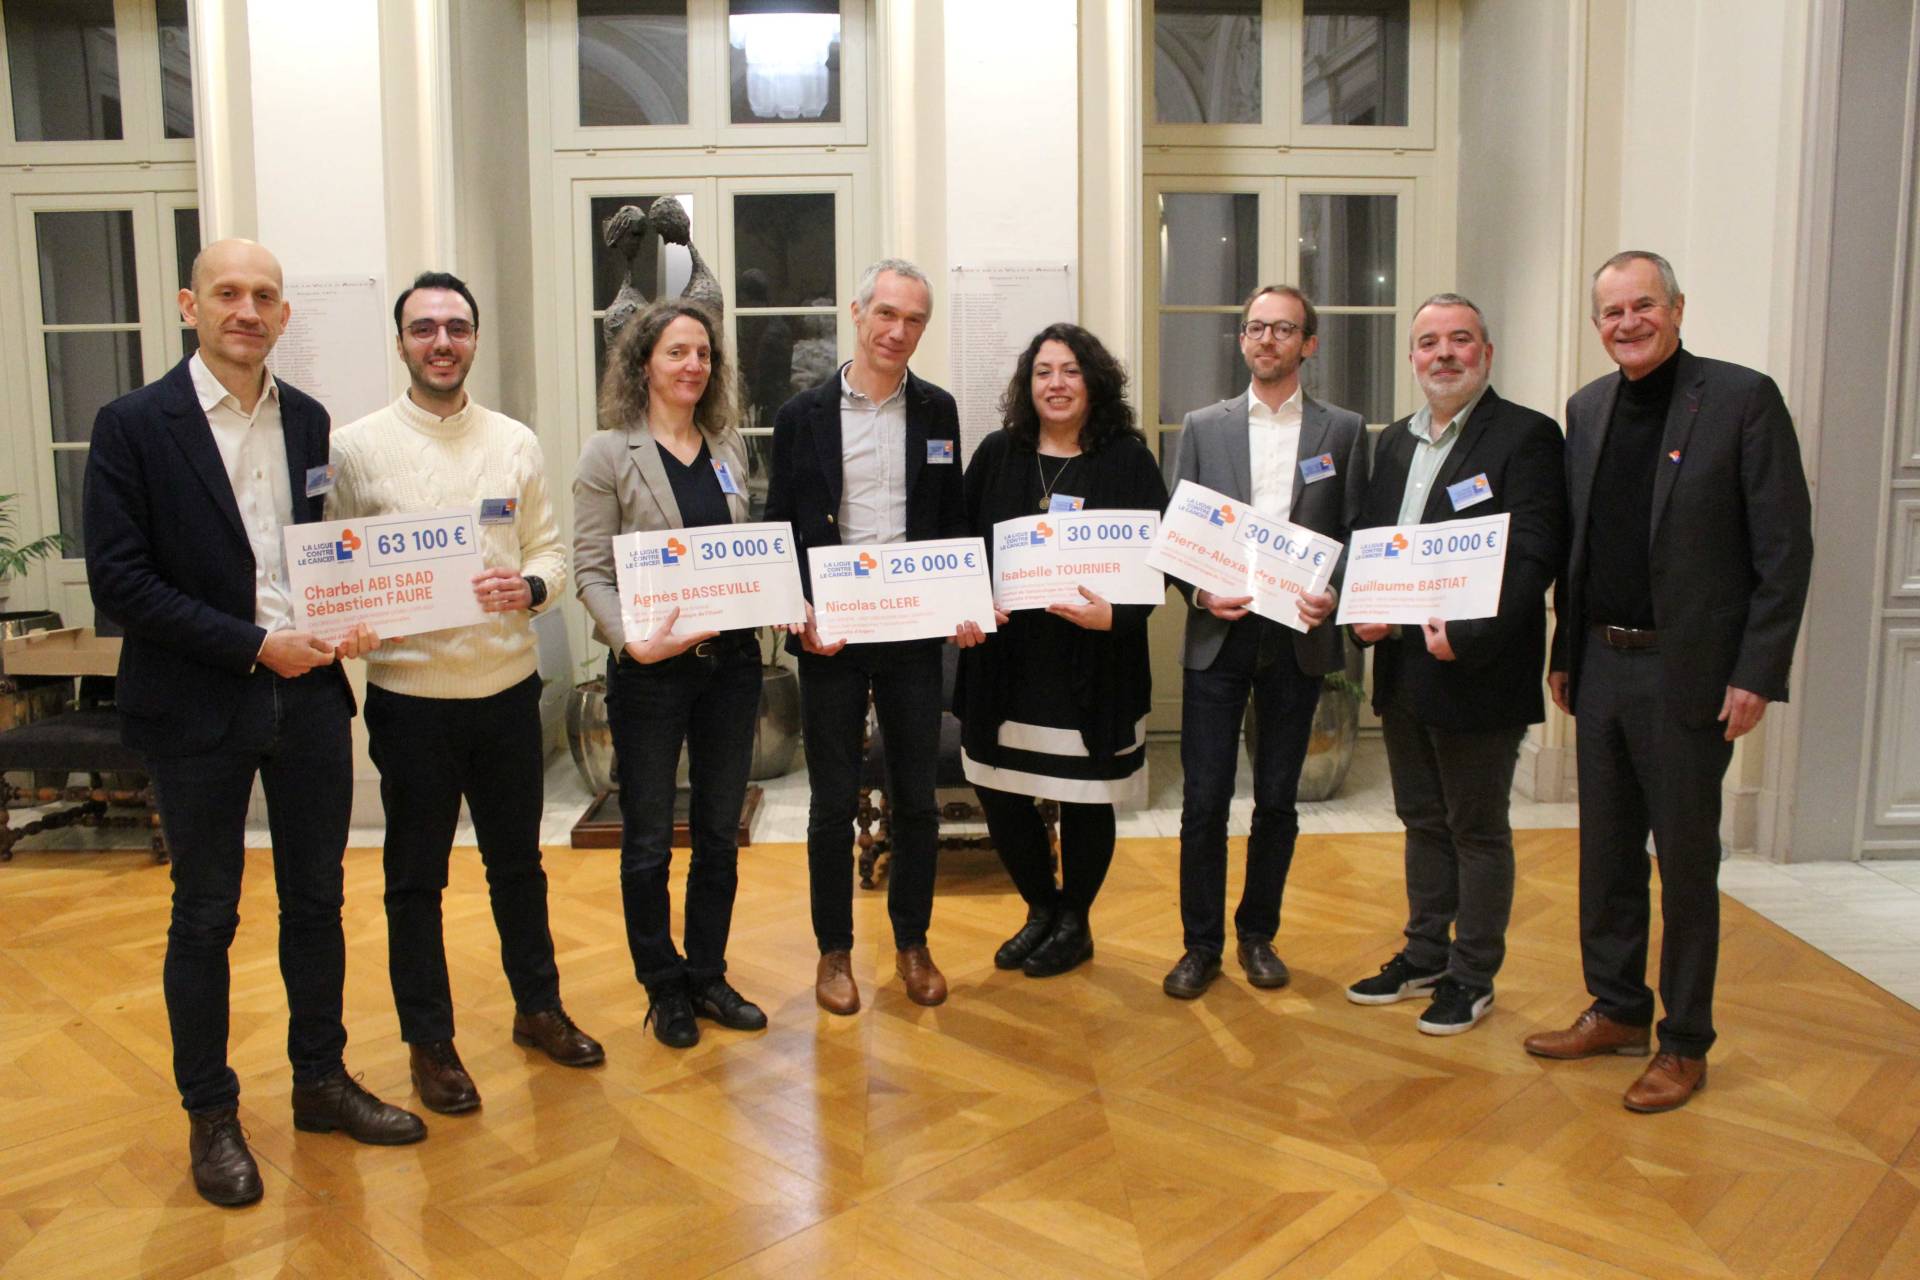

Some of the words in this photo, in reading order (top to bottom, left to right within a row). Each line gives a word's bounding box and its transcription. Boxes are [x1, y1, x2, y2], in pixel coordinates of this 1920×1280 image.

[378, 533, 405, 555] 63
[412, 528, 448, 551] 100
[454, 526, 467, 546] €
[1067, 525, 1091, 542] 30
[1097, 524, 1133, 541] 000
[1138, 524, 1151, 540] €
[1422, 539, 1443, 557] 30
[1448, 533, 1481, 553] 000
[1487, 531, 1497, 548] €
[306, 549, 334, 558] CONTRE
[313, 542, 334, 550] LIGUE
[701, 541, 727, 561] 30
[733, 539, 768, 558] 000
[774, 537, 785, 555] €
[1244, 523, 1269, 544] 30
[1313, 551, 1327, 567] €
[298, 558, 306, 566] LE
[307, 555, 335, 564] CANCER
[890, 557, 916, 575] 26
[922, 553, 958, 572] 000
[964, 552, 976, 569] €
[1167, 530, 1276, 585] Pierre-Alexadre
[1001, 566, 1052, 581] Isabelle
[1056, 562, 1121, 576] TOURNIER
[304, 579, 364, 601] Charbel
[368, 576, 392, 592] ABI
[395, 570, 434, 588] SAAD
[633, 590, 678, 608] Agnès
[681, 580, 761, 601] BASSEVILLE
[1351, 579, 1414, 593] Guillaume
[1418, 576, 1468, 592] BASTIAT
[306, 594, 383, 617] Sébastien
[386, 586, 433, 605] FAURE
[825, 599, 877, 613] Nicolas
[880, 596, 921, 610] CLERE
